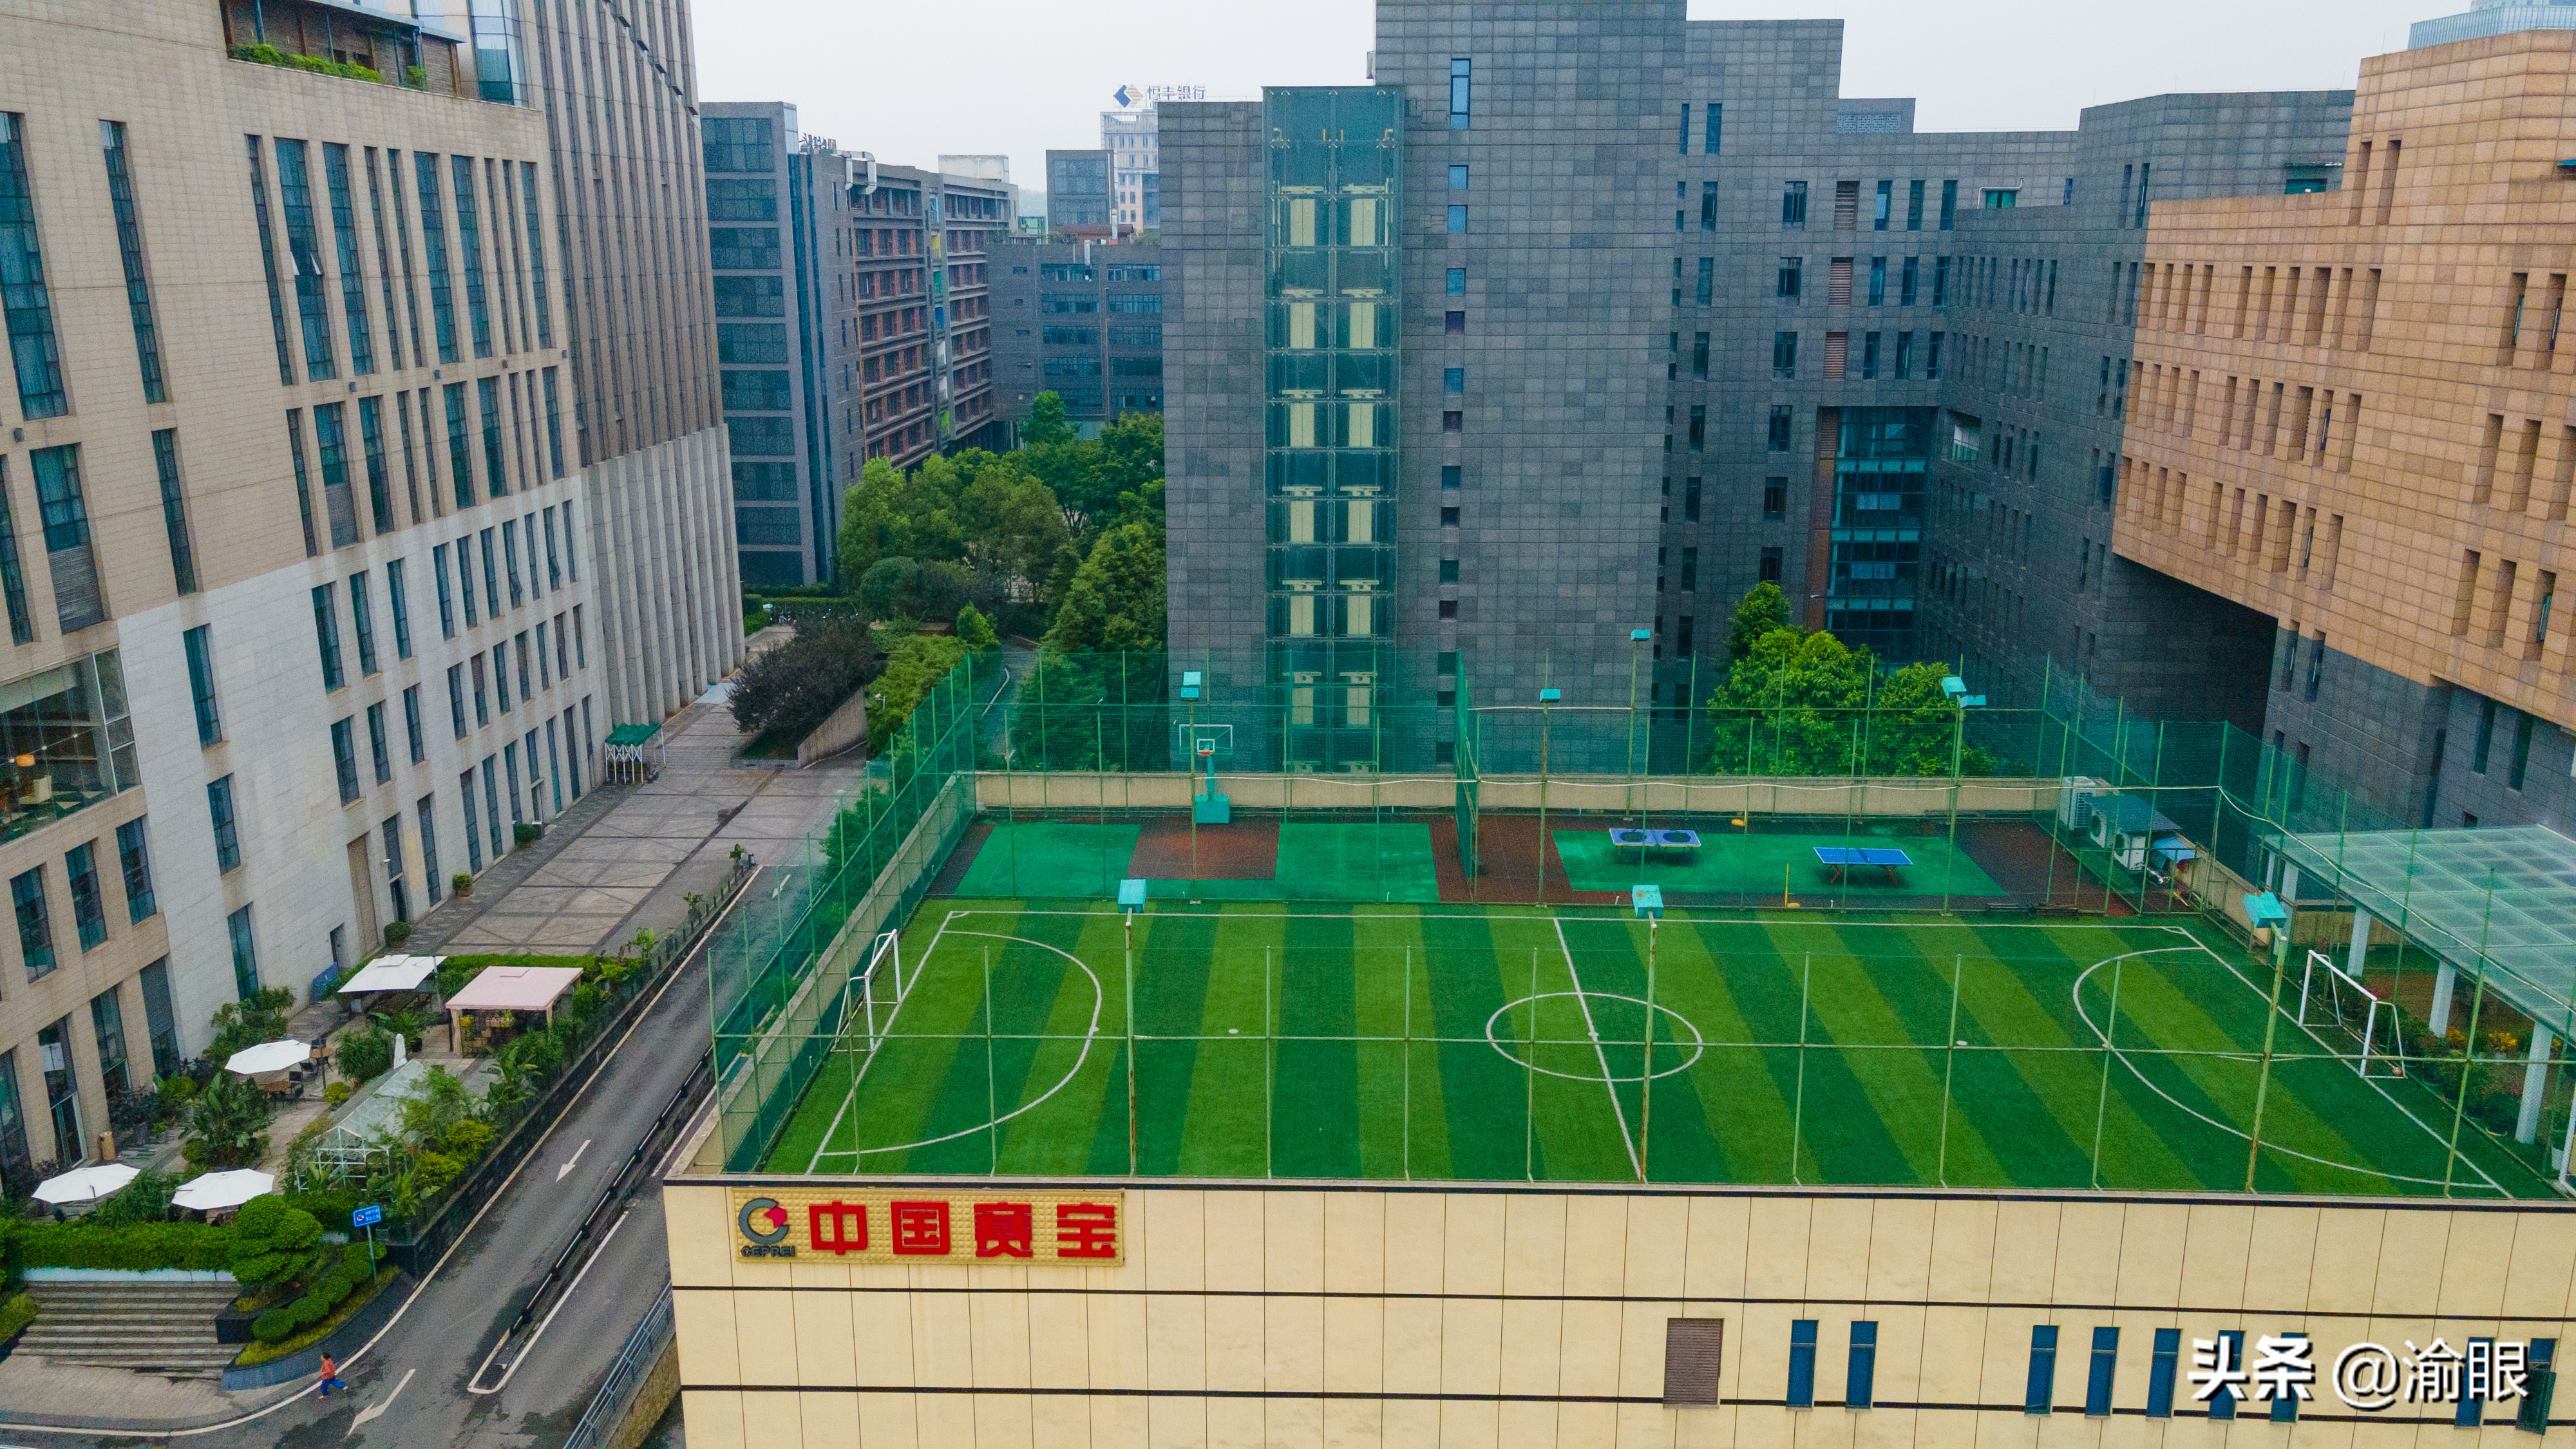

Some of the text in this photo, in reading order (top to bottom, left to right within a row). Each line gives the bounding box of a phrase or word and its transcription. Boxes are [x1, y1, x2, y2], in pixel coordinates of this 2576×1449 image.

[1147, 85, 1206, 100] 恒丰银行
[808, 1200, 1115, 1258] 中国赛宝
[741, 1245, 795, 1257] CEPREI
